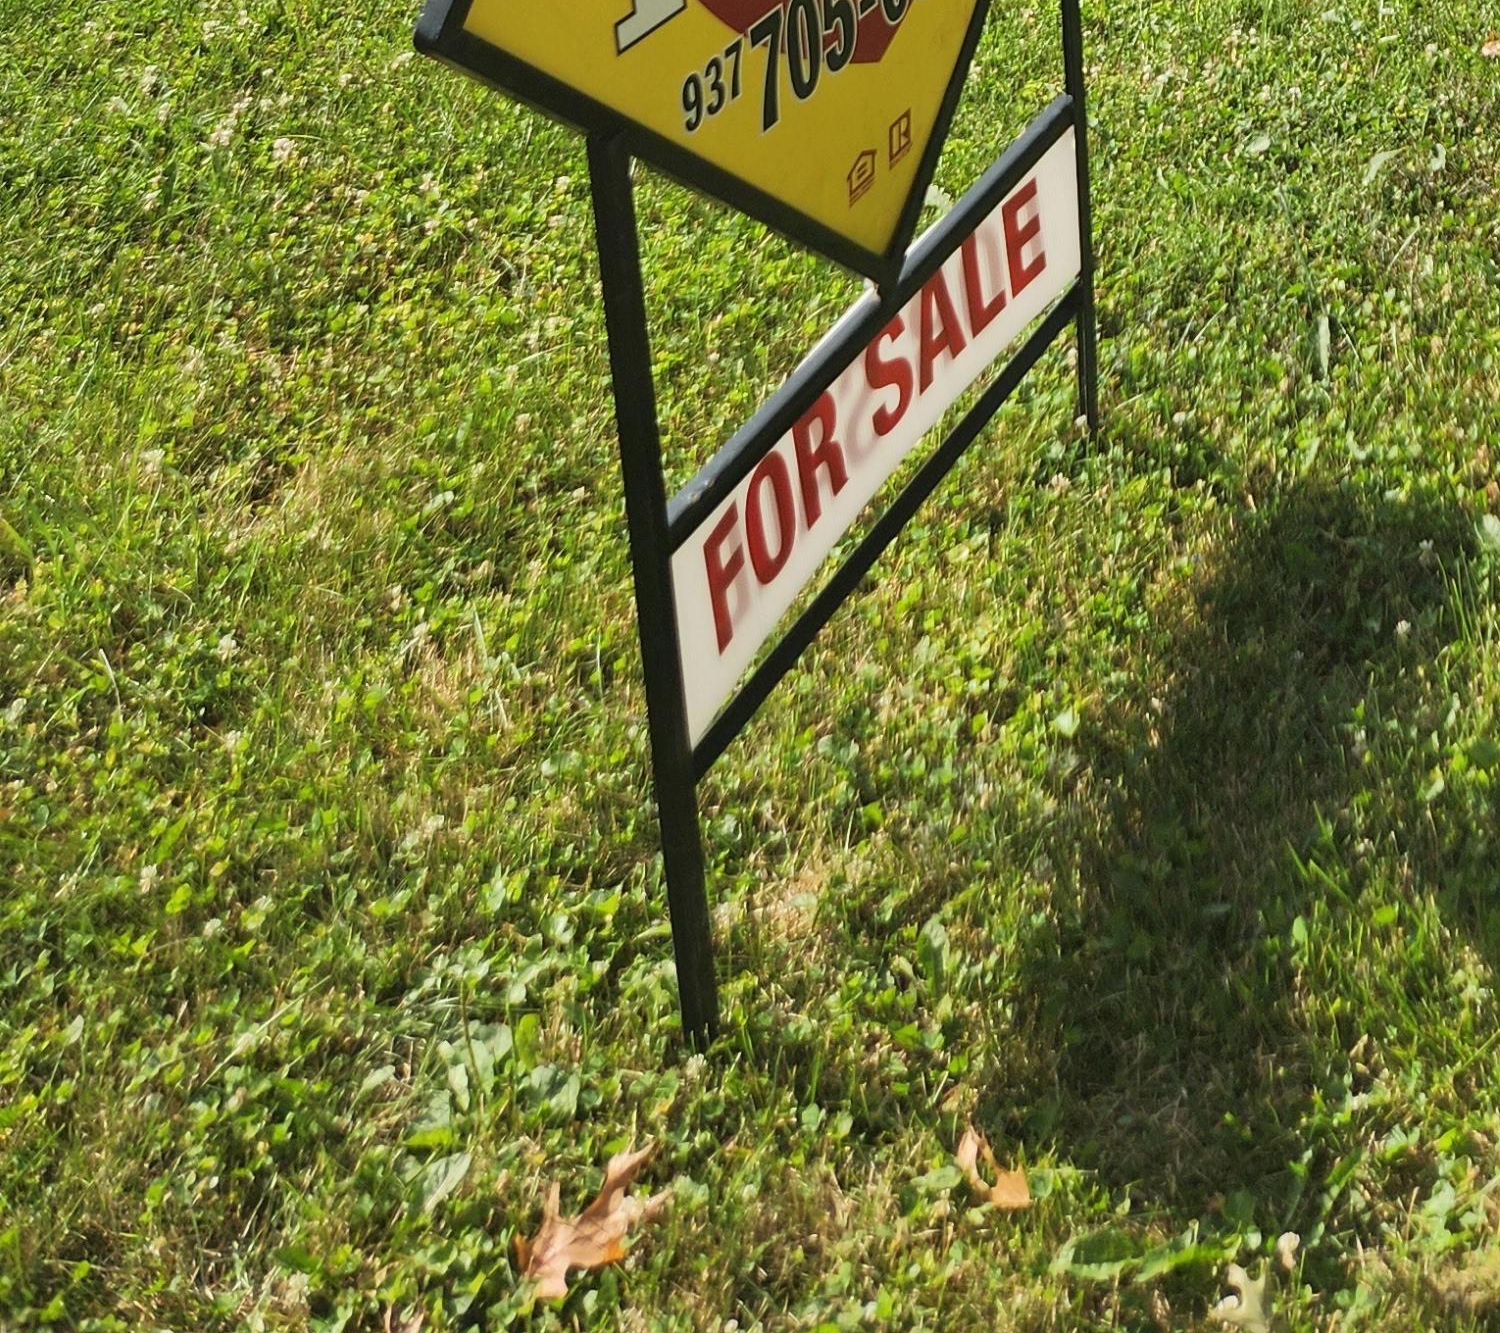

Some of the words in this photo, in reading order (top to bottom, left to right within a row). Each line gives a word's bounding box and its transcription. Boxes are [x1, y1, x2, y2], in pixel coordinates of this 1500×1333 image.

[681, 33, 745, 134] 937
[703, 389, 848, 656] FOR
[866, 177, 1047, 438] SALE
